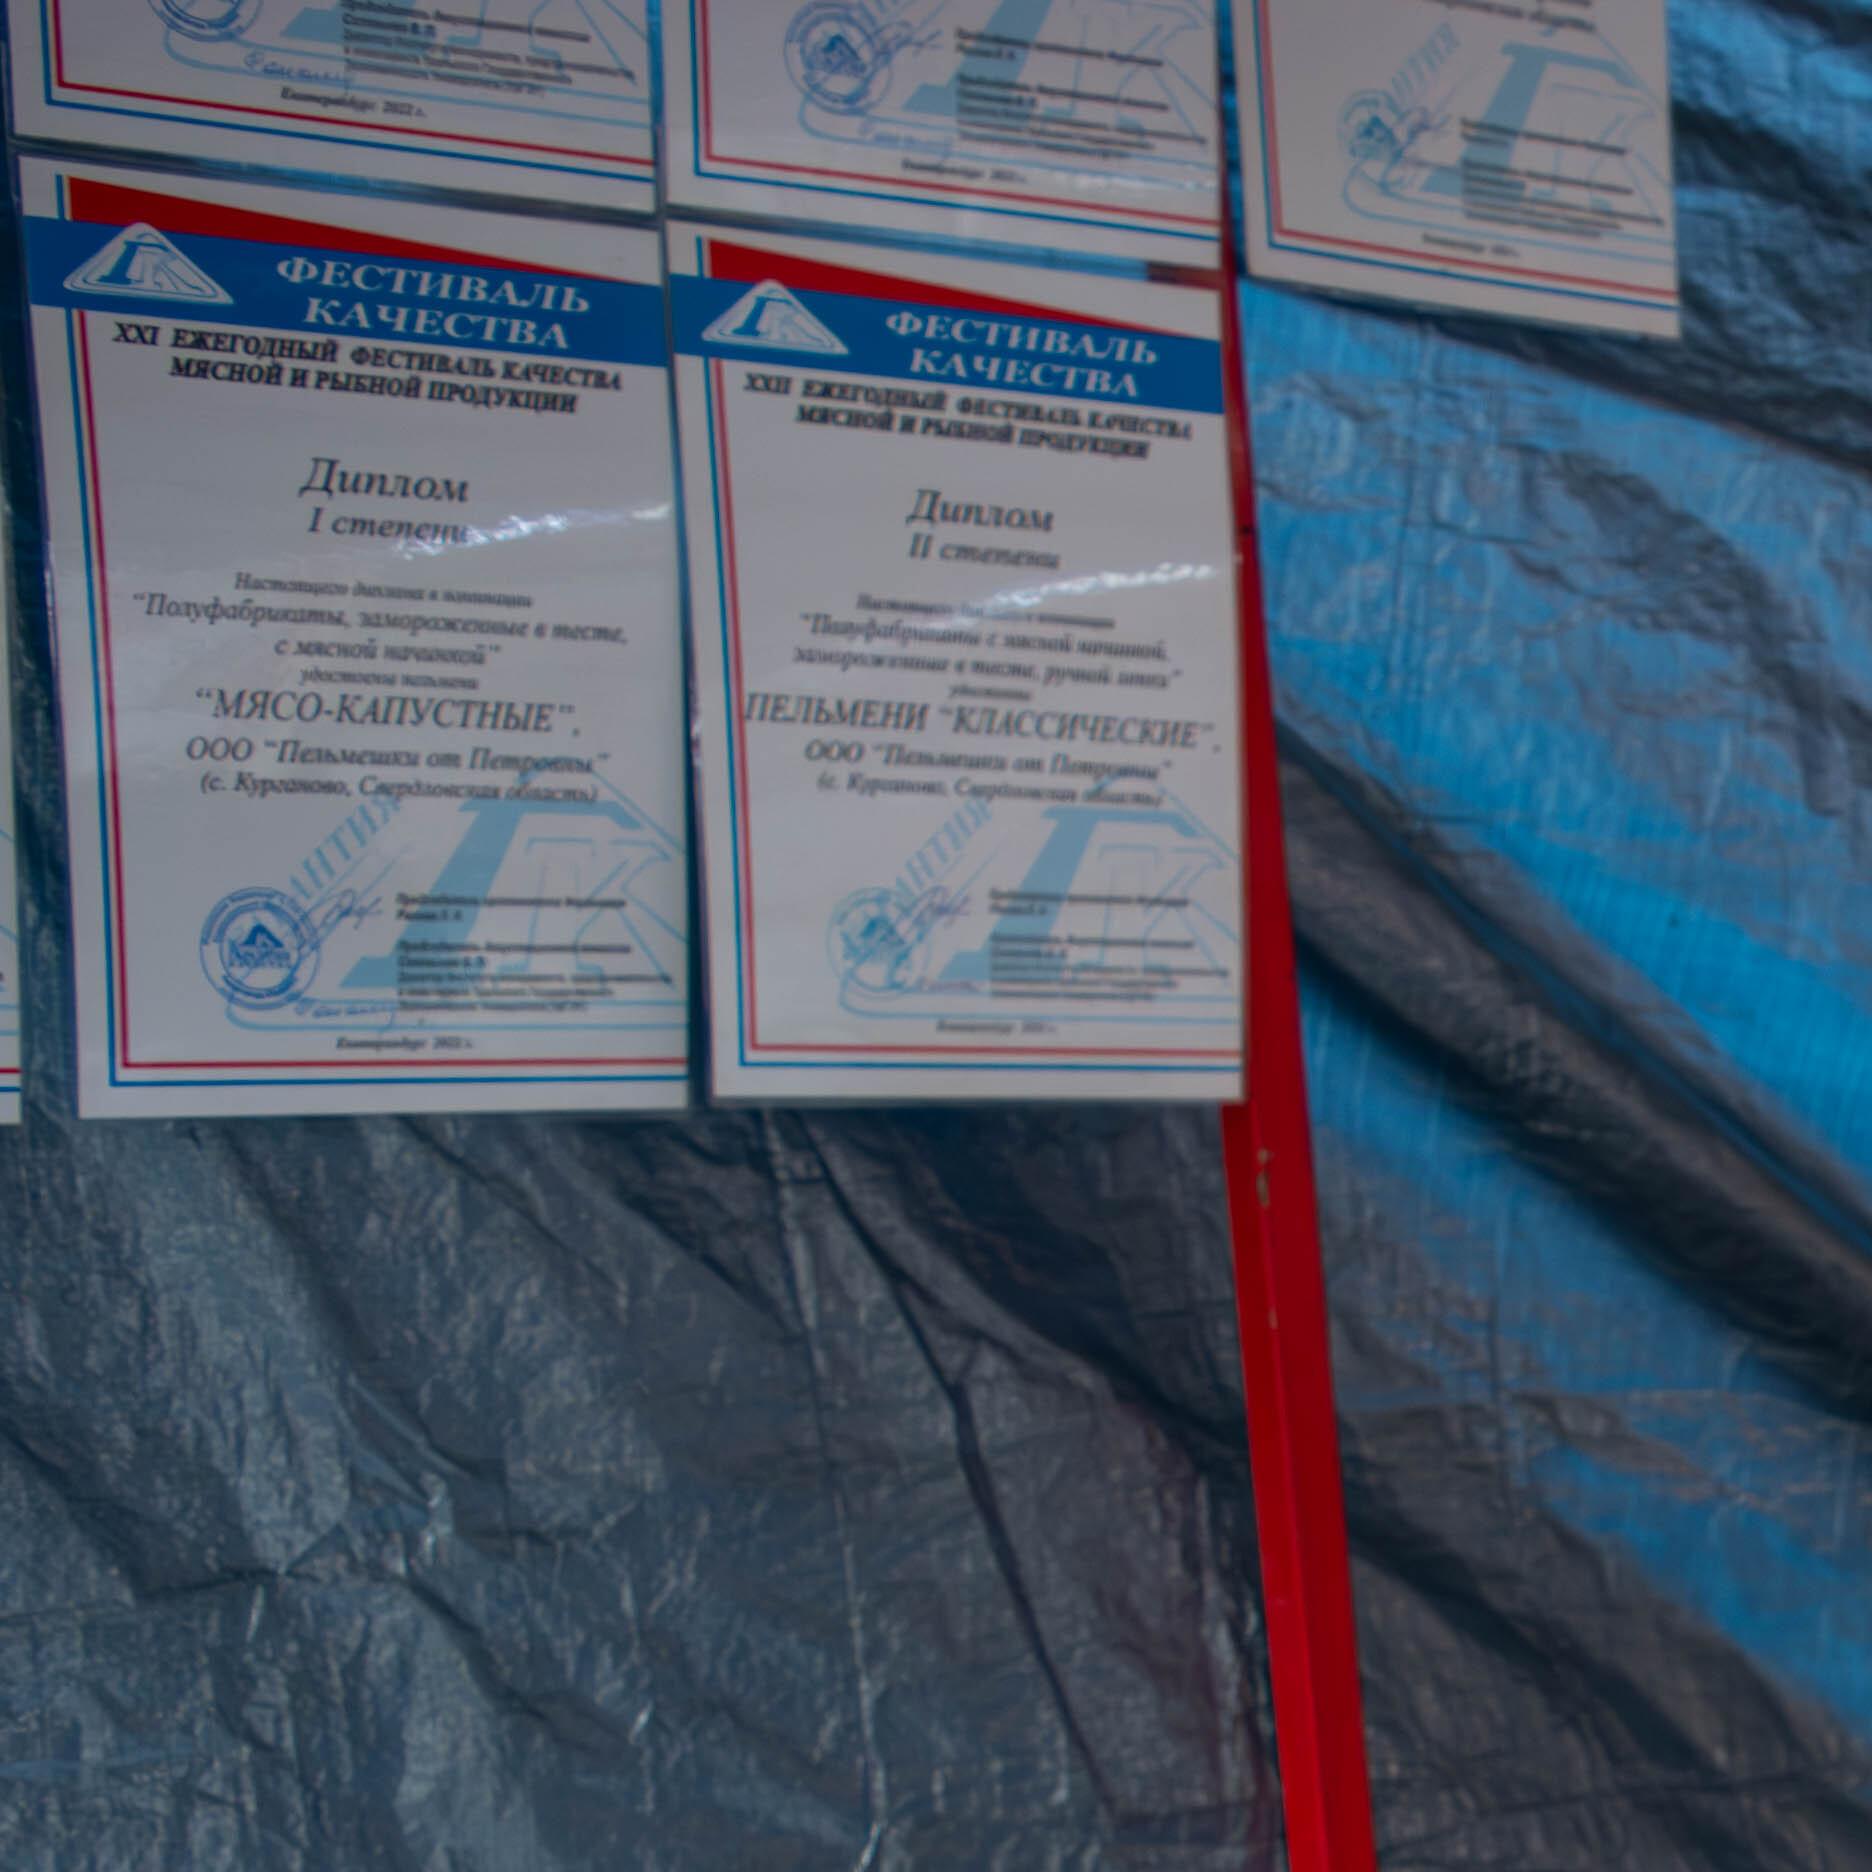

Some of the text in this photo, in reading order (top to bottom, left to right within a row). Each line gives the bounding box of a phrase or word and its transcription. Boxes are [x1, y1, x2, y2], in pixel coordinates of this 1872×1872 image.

[276, 254, 591, 313] ФЕСТИВАЛЬ
[303, 297, 569, 350] КАЧЕСТВА
[884, 310, 1160, 366] ФЕСТИВАЛЬ
[169, 326, 338, 364] ЕЖЕГОДНЫЙ
[350, 344, 496, 379] ФЕСТИВАЛЬ
[501, 359, 623, 392] КАЧЕСТВА
[169, 355, 579, 414] МЯСНОЙ И РЫБНОЙ ПРОДУКЦИИ
[909, 347, 1141, 399] КАЧЕСТВА
[796, 404, 894, 433] МЯСНОЙ
[921, 416, 1015, 445] РЫБНОЙ
[1018, 428, 1150, 461] ПРОДУКЦИИ
[801, 378, 948, 413] ЕЖЕГОДНЫЙ
[956, 396, 1082, 427] ФЕСТИВАЛЬ
[1088, 411, 1194, 440] КАЧЕСТВА
[298, 457, 470, 505] Диплом
[331, 511, 471, 546] степени
[905, 488, 1056, 532] Диплом
[939, 538, 1062, 571] степени
[743, 692, 931, 734] ПЕЛЬМЕНИ
[185, 734, 253, 762] ООО
